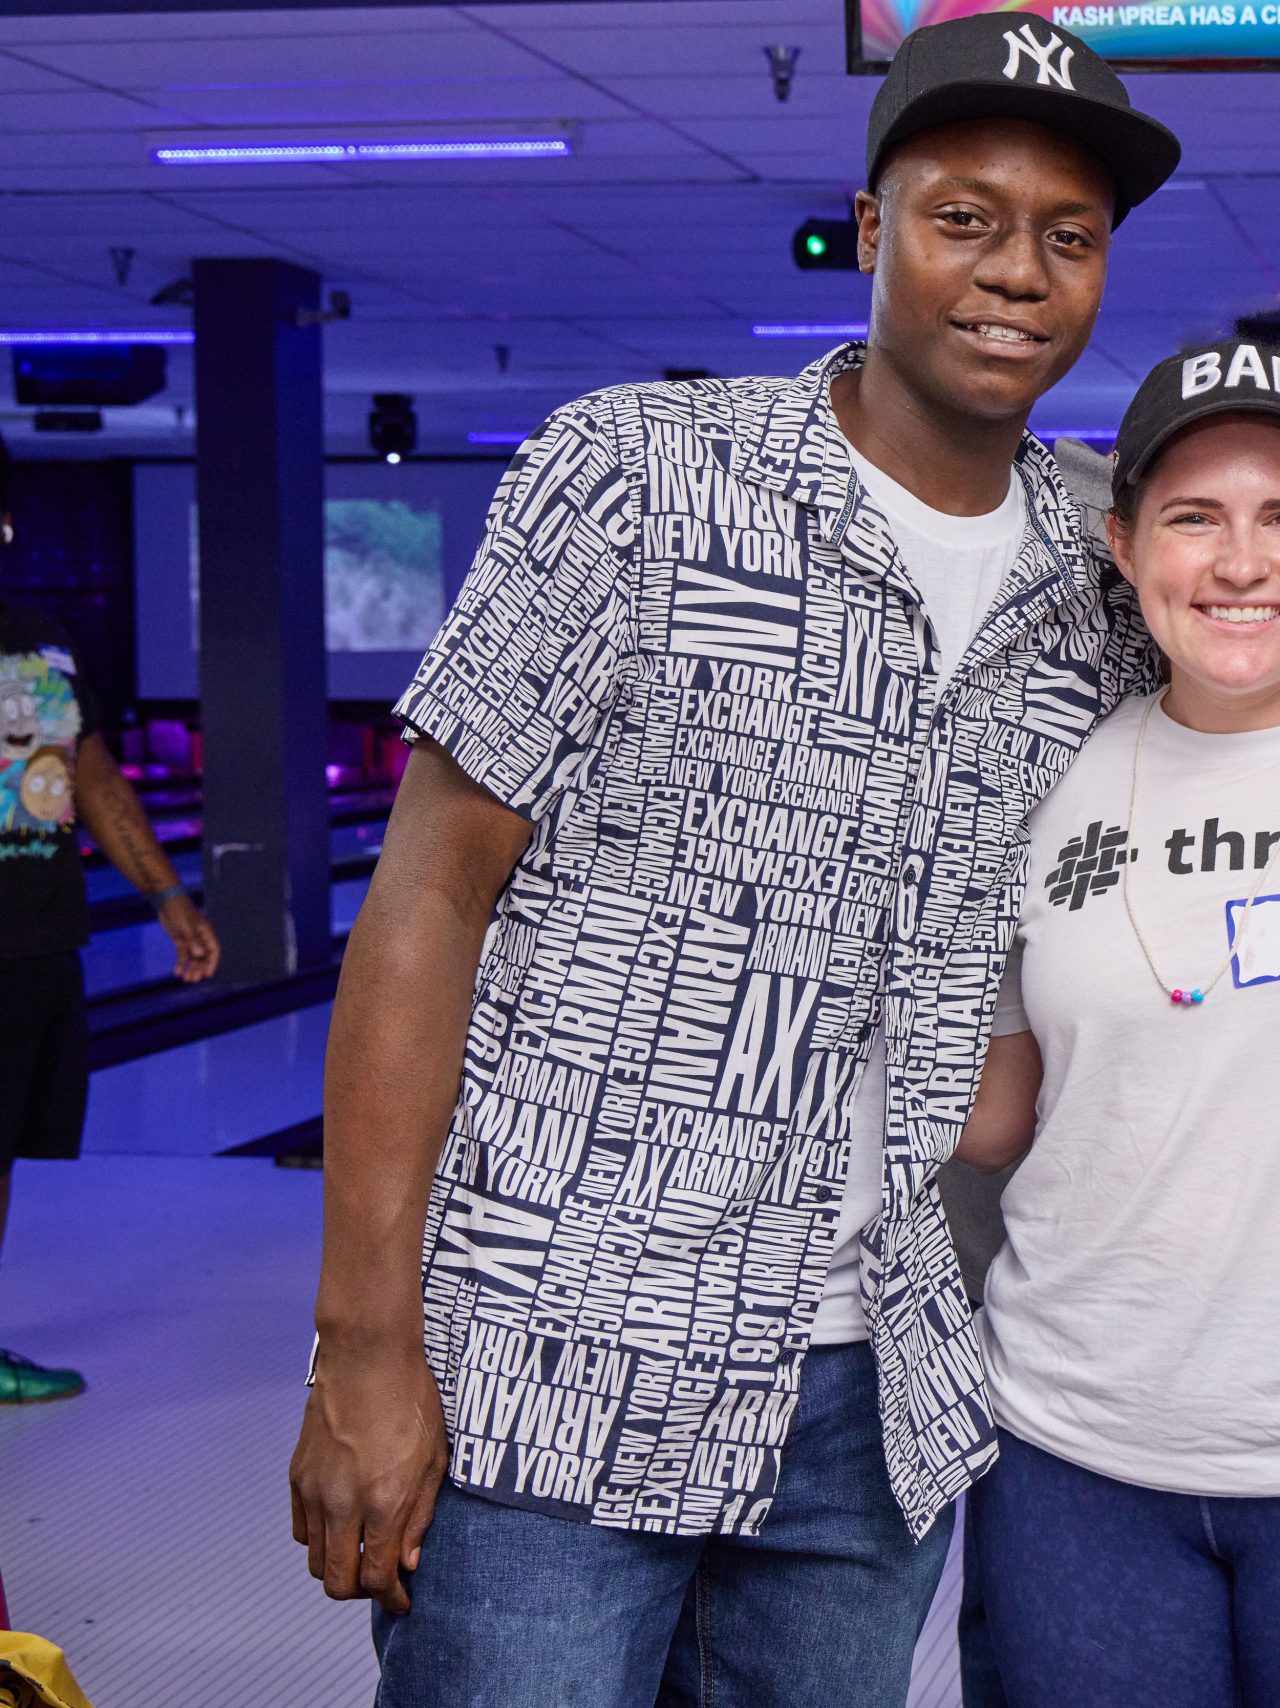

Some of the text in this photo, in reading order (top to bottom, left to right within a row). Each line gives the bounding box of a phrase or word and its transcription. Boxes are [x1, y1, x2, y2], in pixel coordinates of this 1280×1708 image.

[1052, 5, 1114, 27] KASH
[1190, 4, 1236, 26] HAS
[1240, 4, 1258, 26] A
[1002, 23, 1077, 91] NY
[643, 514, 711, 562] NEW
[720, 526, 804, 581] YORK
[449, 552, 548, 688] EXCHANGE
[476, 605, 546, 709] EXCHANGE
[709, 660, 798, 703] YORK
[674, 728, 777, 773] EXCHANGE
[679, 689, 818, 746] EXCHANGE
[481, 712, 554, 802] ARMANI
[668, 757, 771, 801] NEW YORK
[775, 743, 868, 795] ARMANI
[683, 790, 859, 862] EXCHANGE
[771, 779, 861, 817] EXCHANGE
[851, 733, 909, 876] EXCHANGE
[668, 871, 838, 930] NEW YORK
[509, 880, 591, 1058] EXCHANGE
[547, 887, 652, 1074] ARMANI
[746, 923, 831, 980] ARMANI
[646, 909, 751, 1109] ARMANI
[713, 972, 822, 1119] AX
[491, 1049, 600, 1117] ARMANI
[577, 1078, 644, 1200] NEW YORK
[634, 1101, 787, 1163] EXCHANGE
[486, 1147, 573, 1209] YORK
[615, 1142, 674, 1210] AX
[528, 1195, 609, 1341] EXCHANGE
[573, 1204, 655, 1349] EXCHANGE
[619, 1186, 729, 1360] ARMANI
[740, 1204, 813, 1296] ARMANI
[625, 1354, 677, 1422] YORK
[608, 1428, 657, 1485] NEW
[634, 1362, 722, 1516] EXCHANGE
[687, 1441, 765, 1492] NEW
[514, 1447, 605, 1504] YORK
